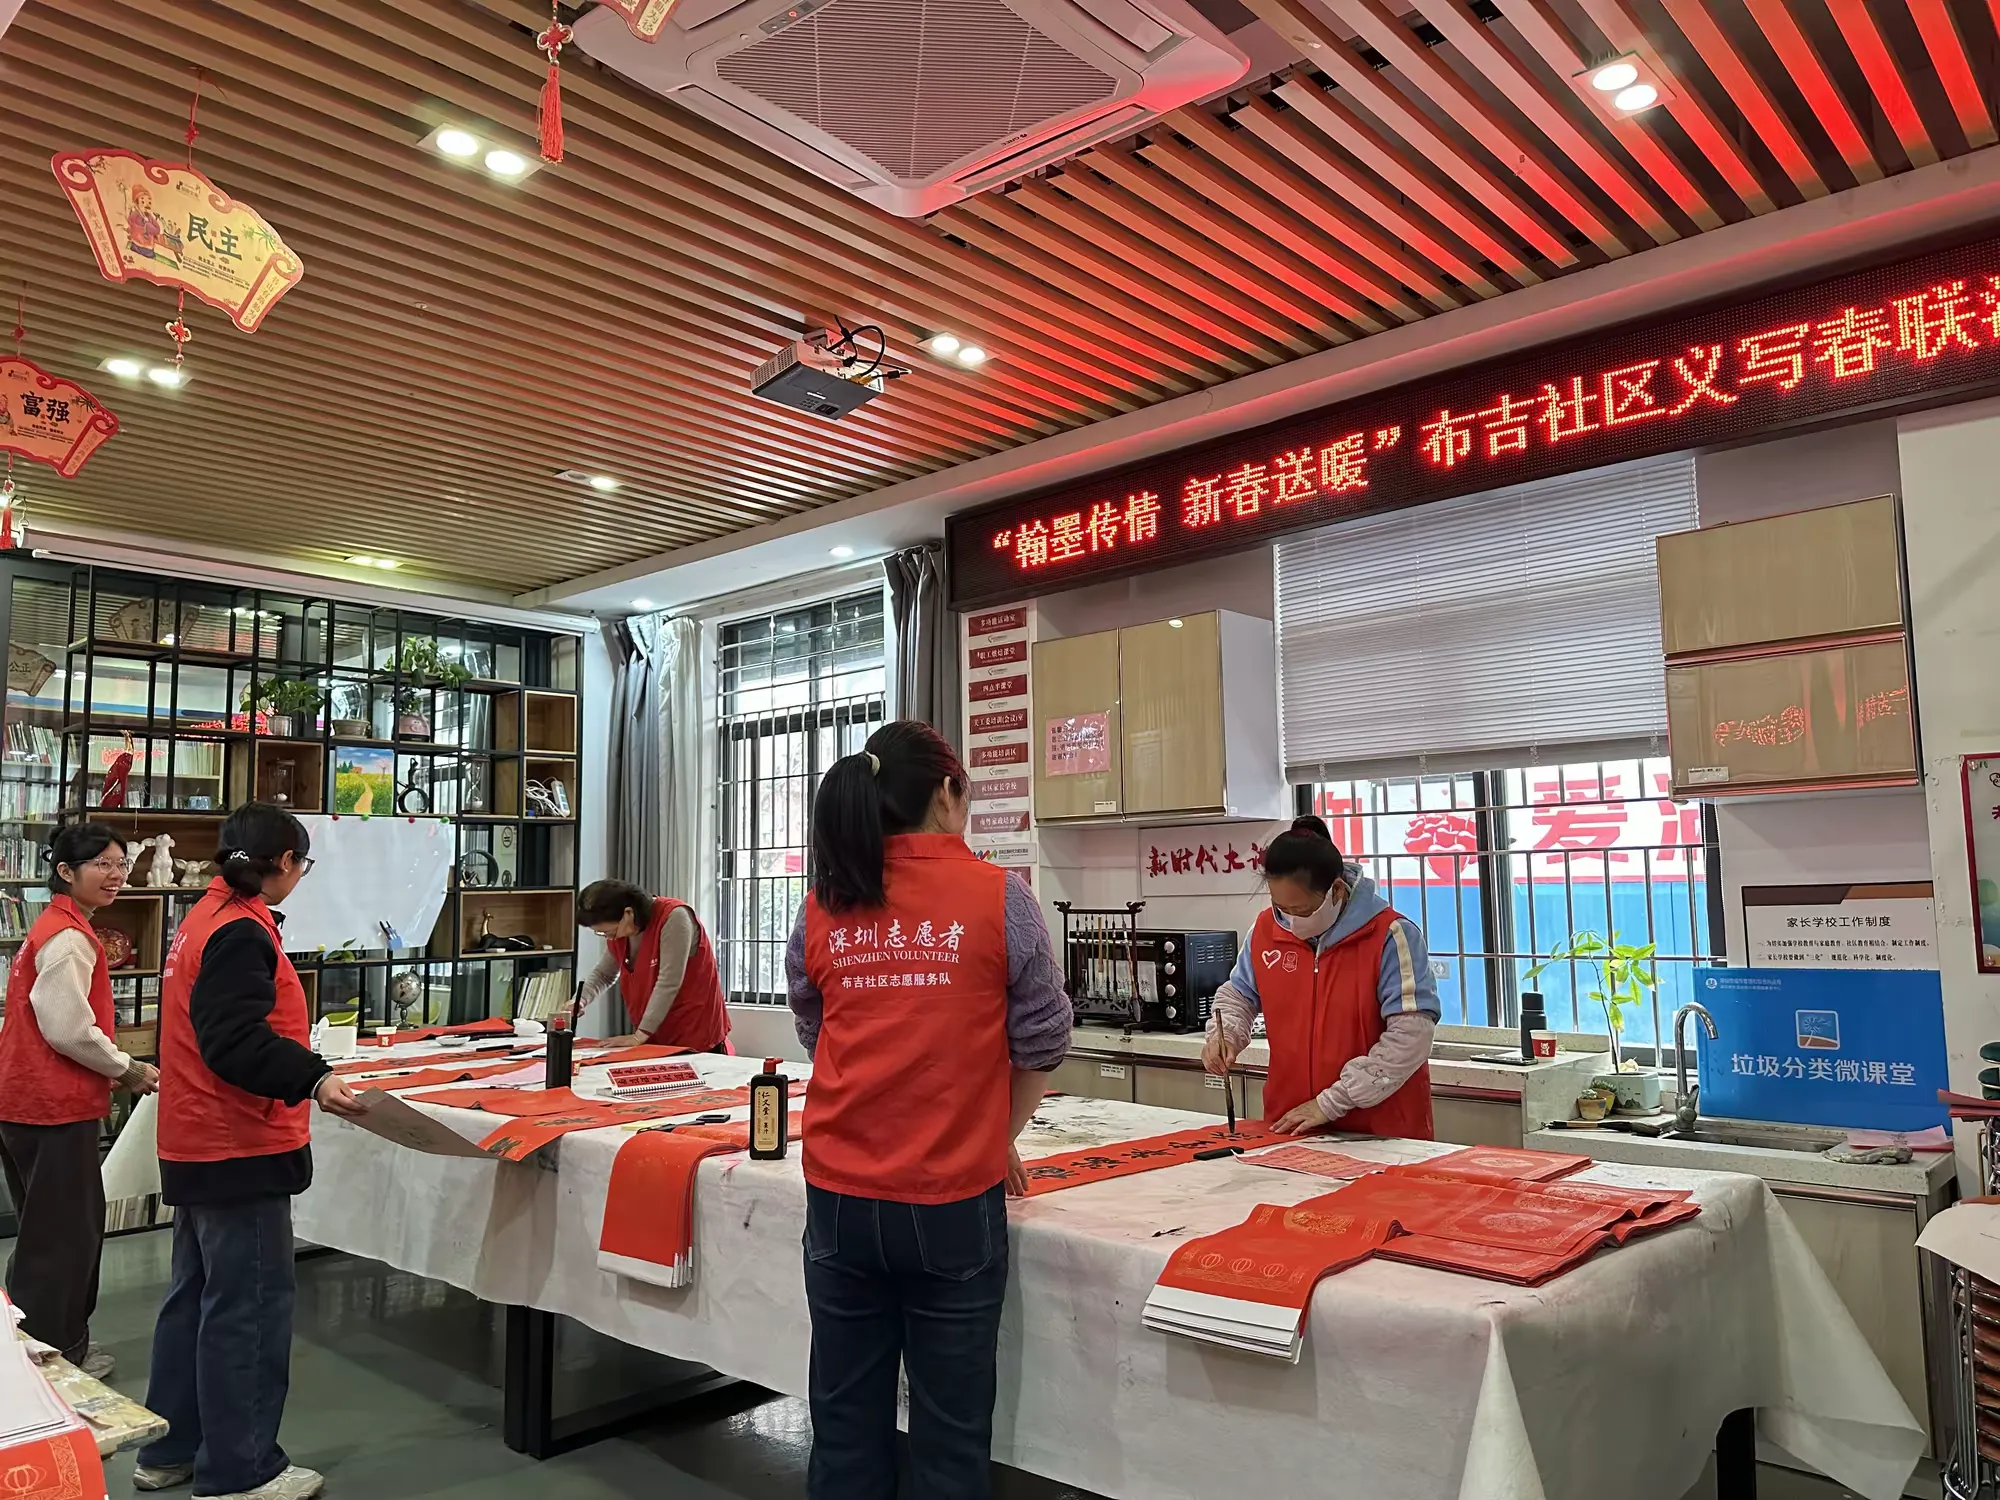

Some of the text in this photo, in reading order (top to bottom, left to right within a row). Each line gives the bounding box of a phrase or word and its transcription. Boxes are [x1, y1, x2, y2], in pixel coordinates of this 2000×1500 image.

[187, 212, 243, 261] 民主
[20, 390, 70, 424] 富强
[992, 491, 1161, 568] “翰墨传情
[1182, 425, 1401, 528] 新春送暖”
[980, 614, 1016, 627] 多功能活动室
[9, 660, 31, 673] 公正
[981, 748, 1017, 759] 多功能培训区
[981, 782, 1017, 793] 社区家长学校
[1786, 916, 1892, 928] 家长学校工作制度
[828, 919, 965, 954] 深圳志愿者
[832, 950, 960, 969] SHENZHEN VOLUNTEER
[841, 972, 952, 989] 布吉社区志愿服务队
[1731, 1053, 1917, 1086] 垃圾分类微课堂
